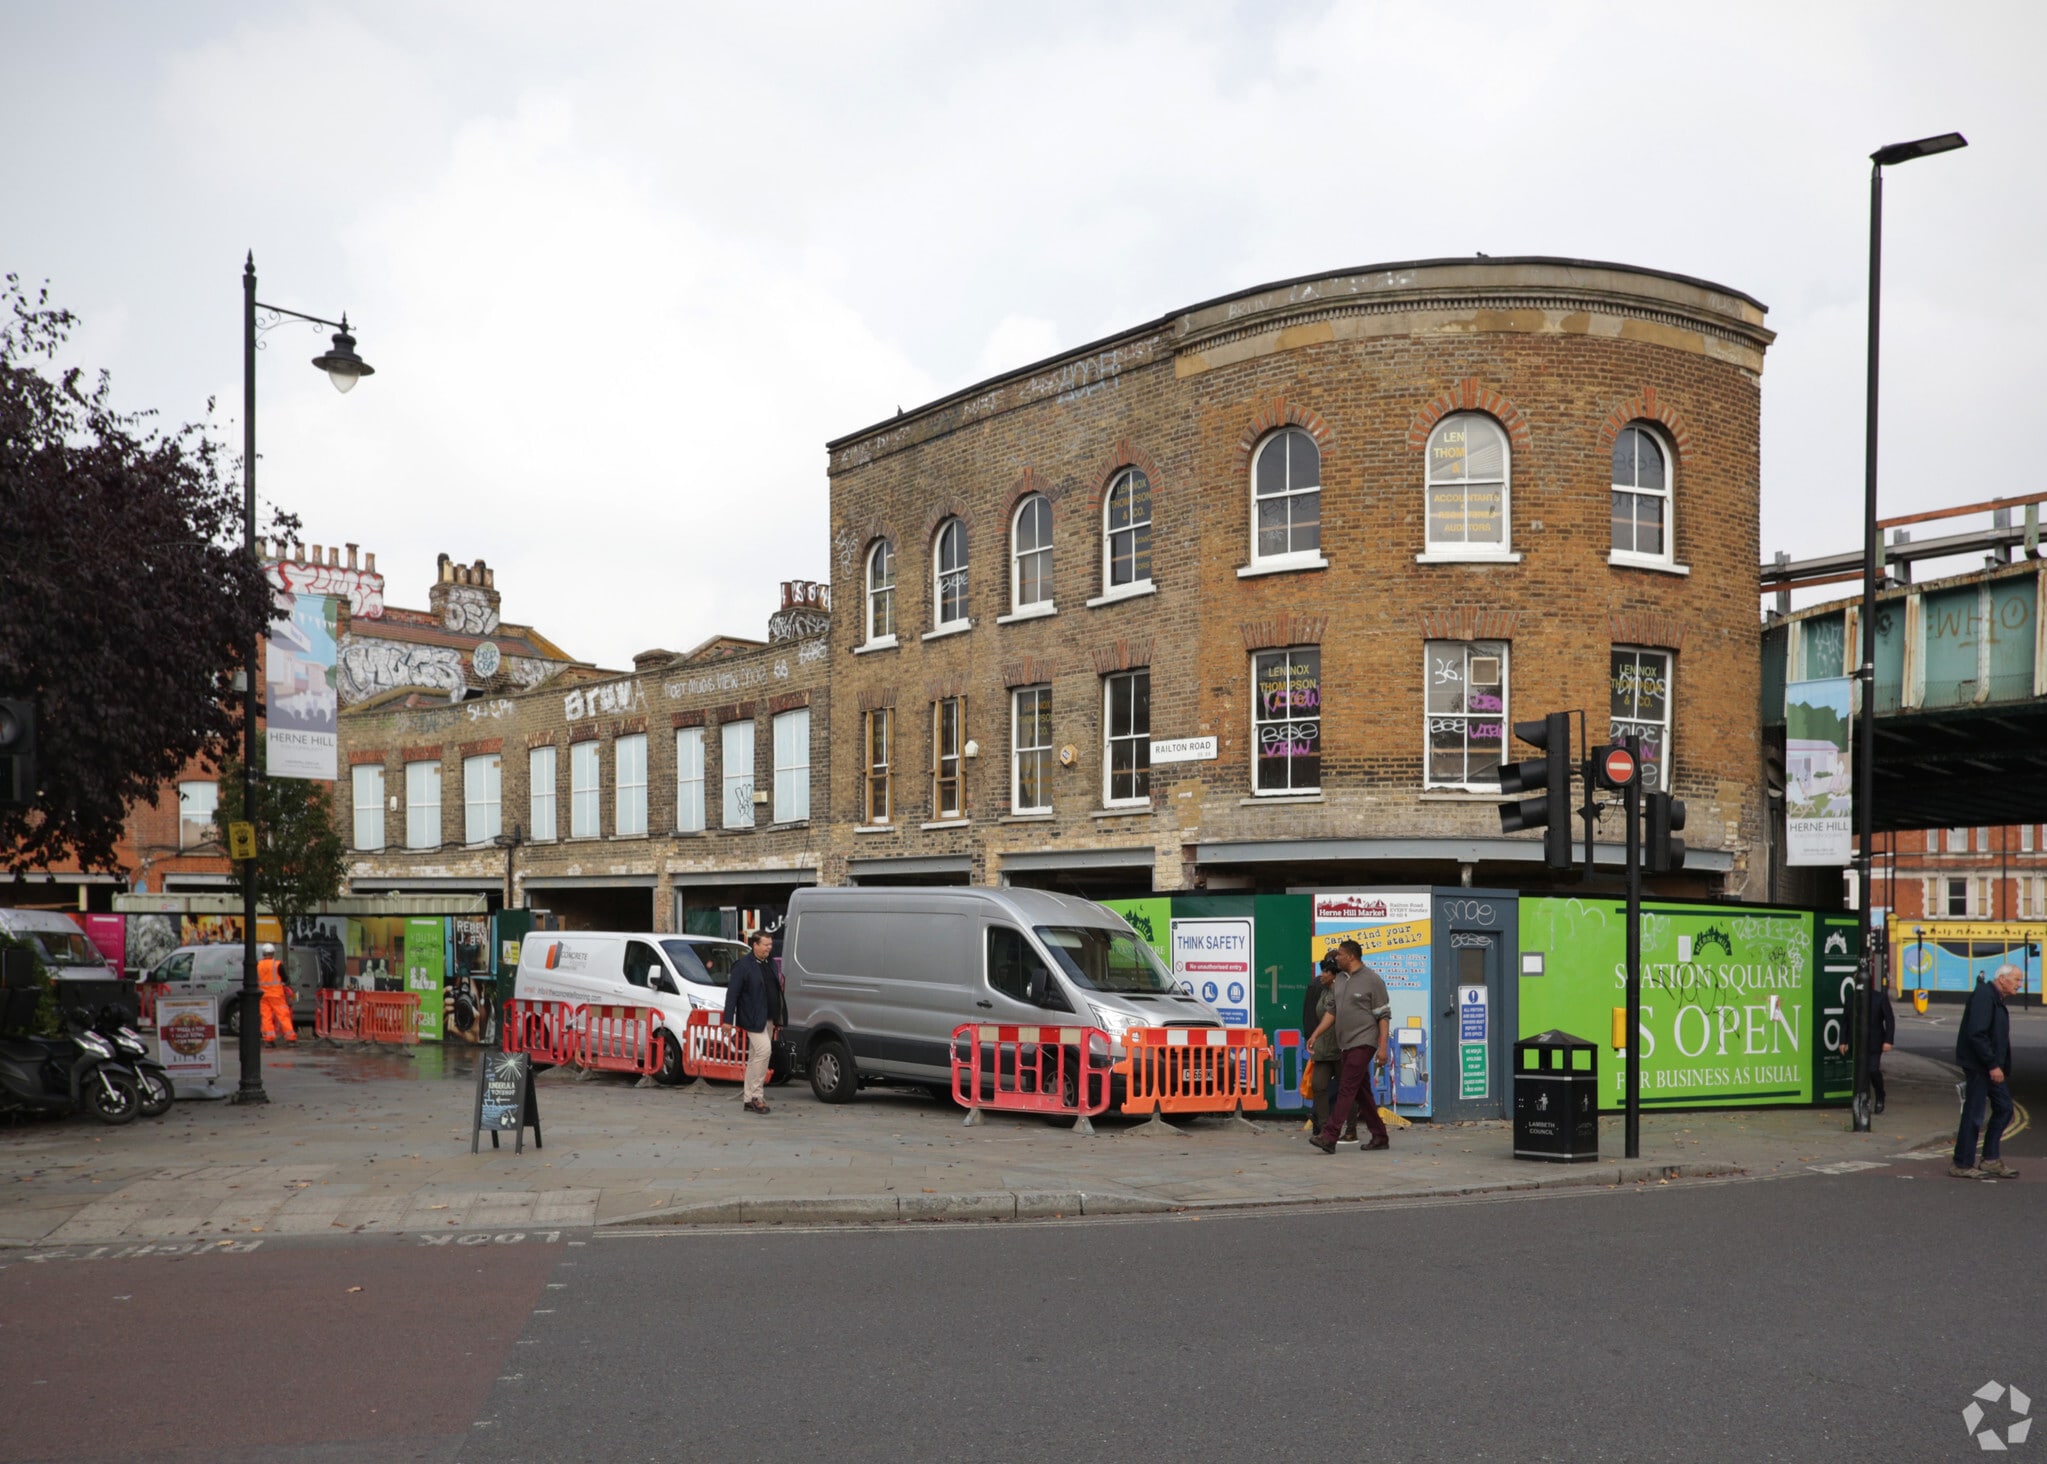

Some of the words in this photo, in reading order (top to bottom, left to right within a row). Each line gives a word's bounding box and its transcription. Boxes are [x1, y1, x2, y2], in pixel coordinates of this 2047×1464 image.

[1268, 664, 1310, 677] LENNOX
[1619, 664, 1657, 678] LENNOX
[1260, 679, 1316, 693] THOMPSON
[1637, 696, 1653, 708] CO.
[270, 732, 308, 745] HERNE
[310, 735, 335, 747] HILL
[1155, 743, 1188, 754] RAILTON
[1189, 741, 1211, 751] ROAD
[1790, 822, 1825, 833] HERNE
[1826, 821, 1849, 831] HILL
[1319, 908, 1342, 917] Herne
[1343, 908, 1357, 917] Hill
[1359, 908, 1385, 917] Market
[1324, 934, 1351, 946] Can't
[1357, 929, 1381, 941] find
[1386, 925, 1411, 938] your
[1386, 933, 1423, 946] stall?
[1177, 935, 1204, 950] THINK
[1207, 935, 1246, 950] SAFETY
[560, 951, 589, 961] CONCRETE
[1229, 964, 1243, 972] entry
[1615, 963, 1712, 990] SATION
[1718, 963, 1802, 996] SQUARE
[1616, 1004, 1657, 1059] S
[1673, 1004, 1803, 1058] OPEN
[1616, 1070, 1652, 1090] FR
[1656, 1067, 1730, 1089] BUSINESS
[1733, 1066, 1751, 1084] AS
[1754, 1064, 1801, 1083] USUAL
[1528, 1121, 1556, 1129] LAMBETH
[1529, 1128, 1554, 1136] COUNCIL
[418, 1230, 561, 1247] LOOK
